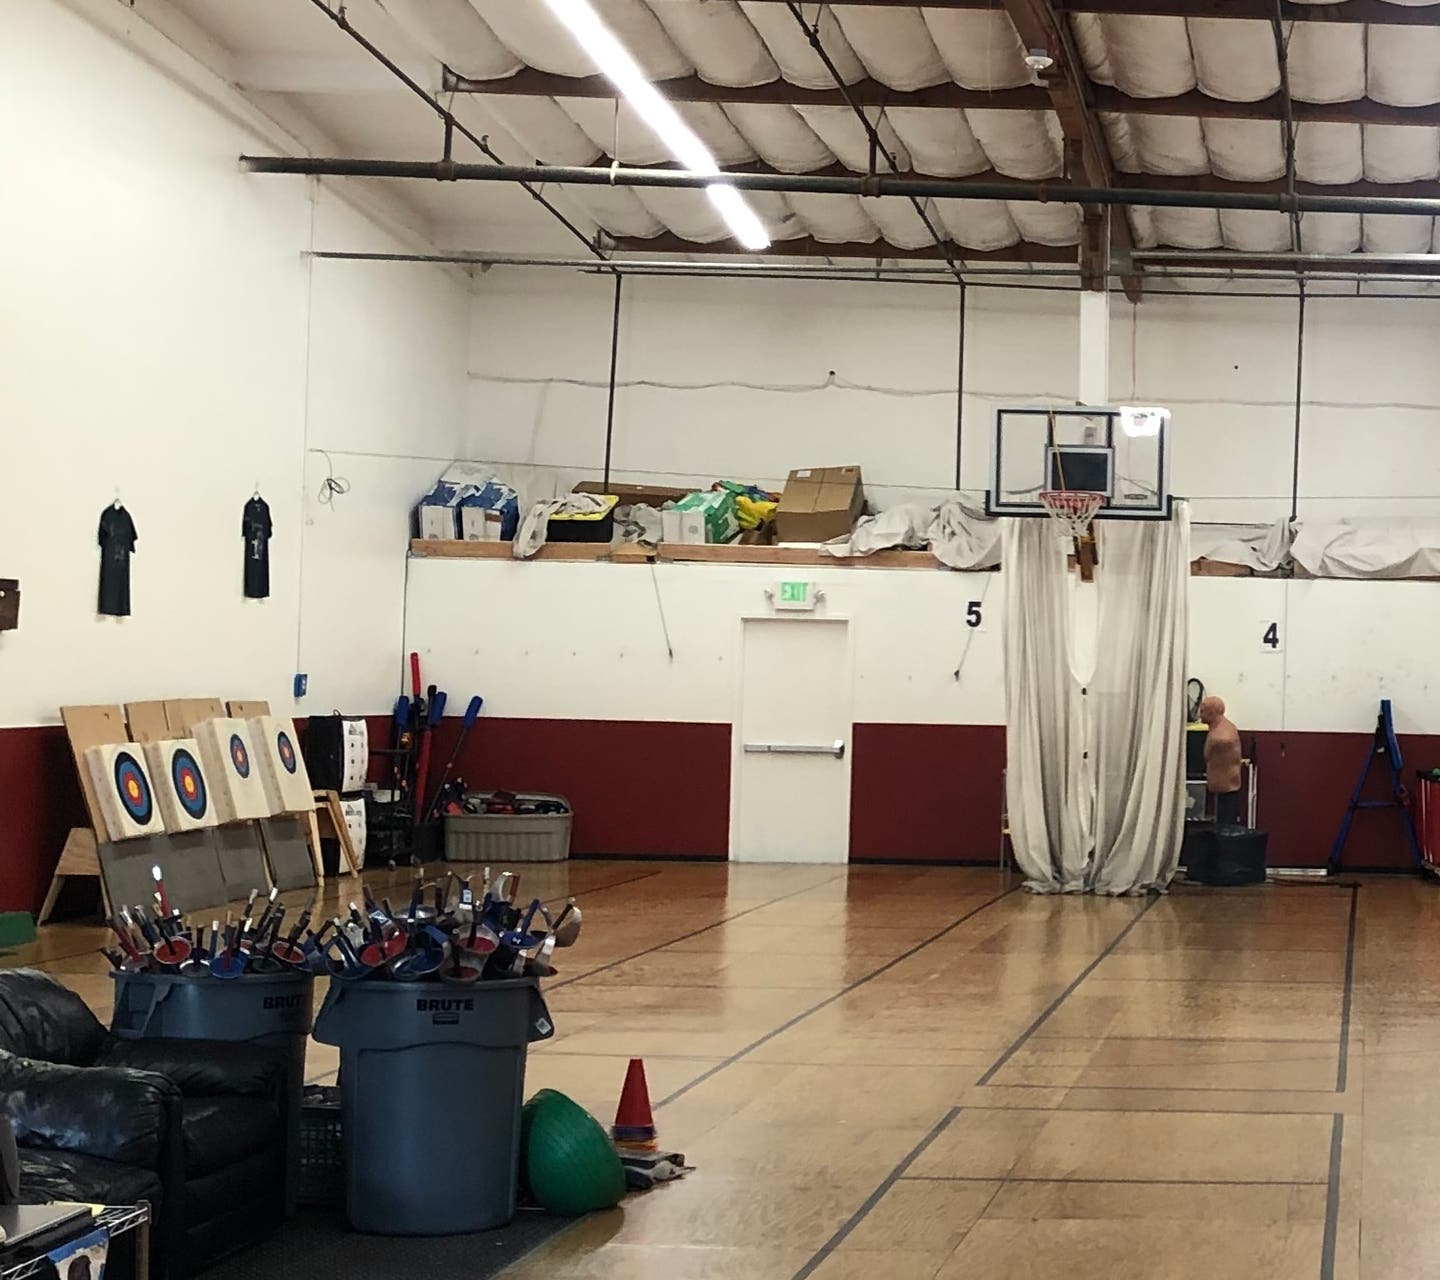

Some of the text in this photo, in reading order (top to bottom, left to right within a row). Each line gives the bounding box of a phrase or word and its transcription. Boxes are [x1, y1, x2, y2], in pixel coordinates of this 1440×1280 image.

[966, 601, 982, 628] 5
[1263, 622, 1279, 649] 4
[264, 994, 304, 1010] BRUT
[416, 998, 474, 1011] BRUTE
